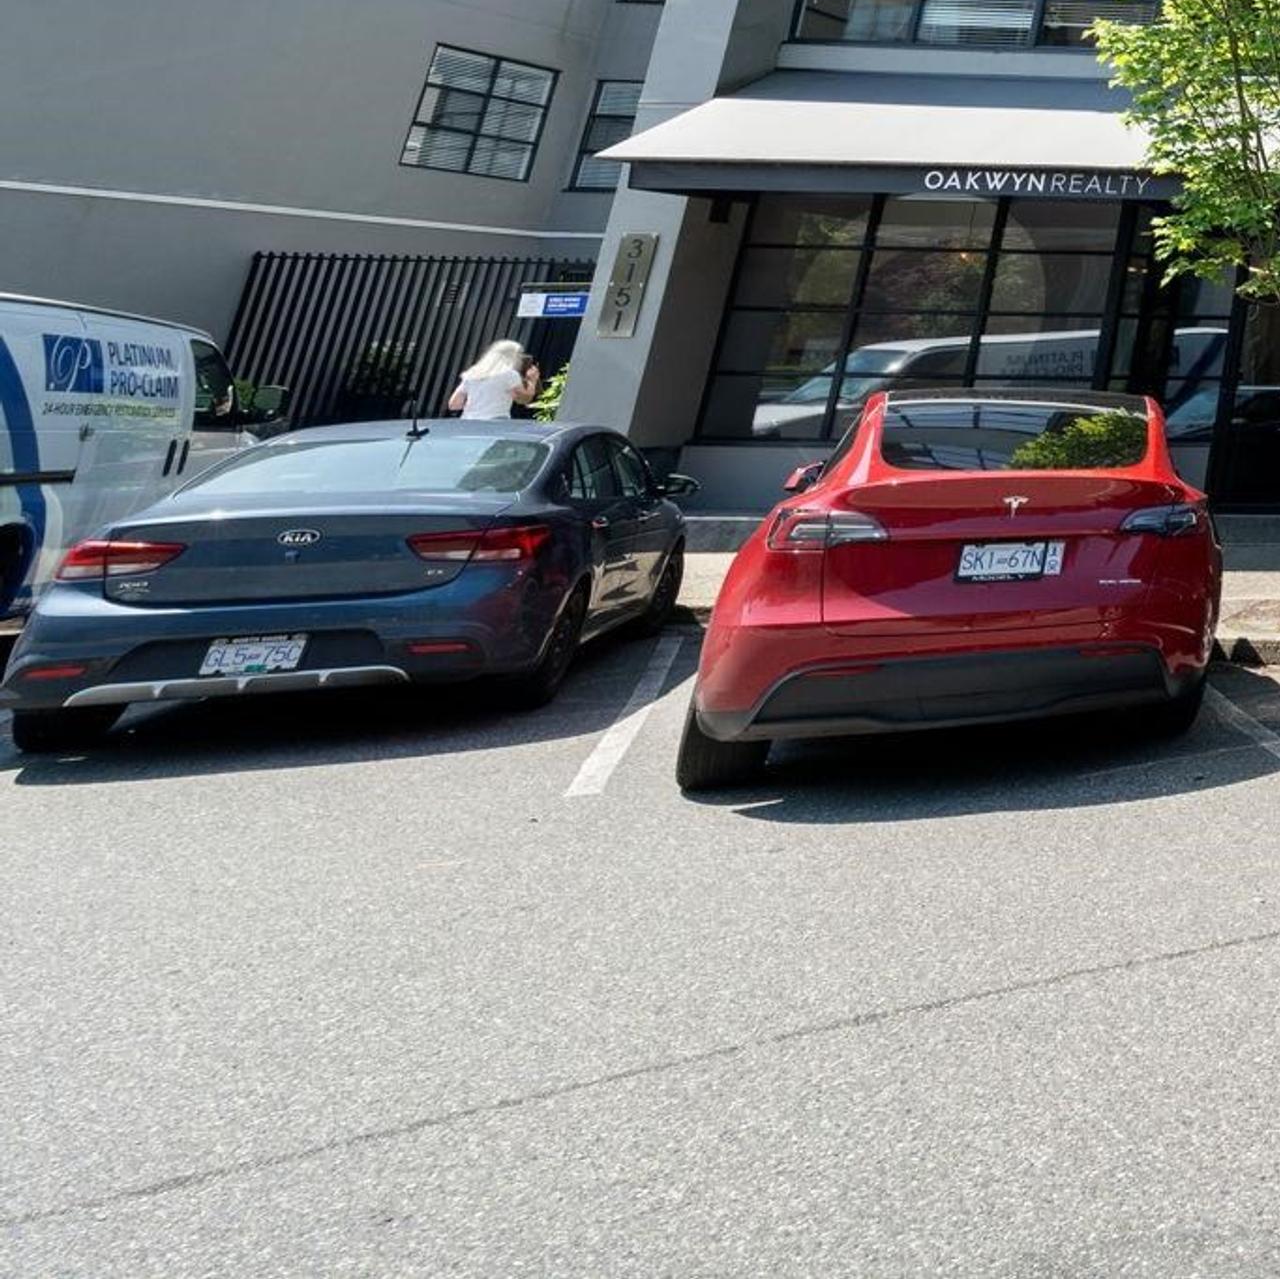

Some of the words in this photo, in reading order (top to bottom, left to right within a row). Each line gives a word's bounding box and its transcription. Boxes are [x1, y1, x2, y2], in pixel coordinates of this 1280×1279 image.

[924, 170, 1046, 192] OAKWYN
[1050, 173, 1151, 195] REALTY
[613, 238, 645, 332] 3151
